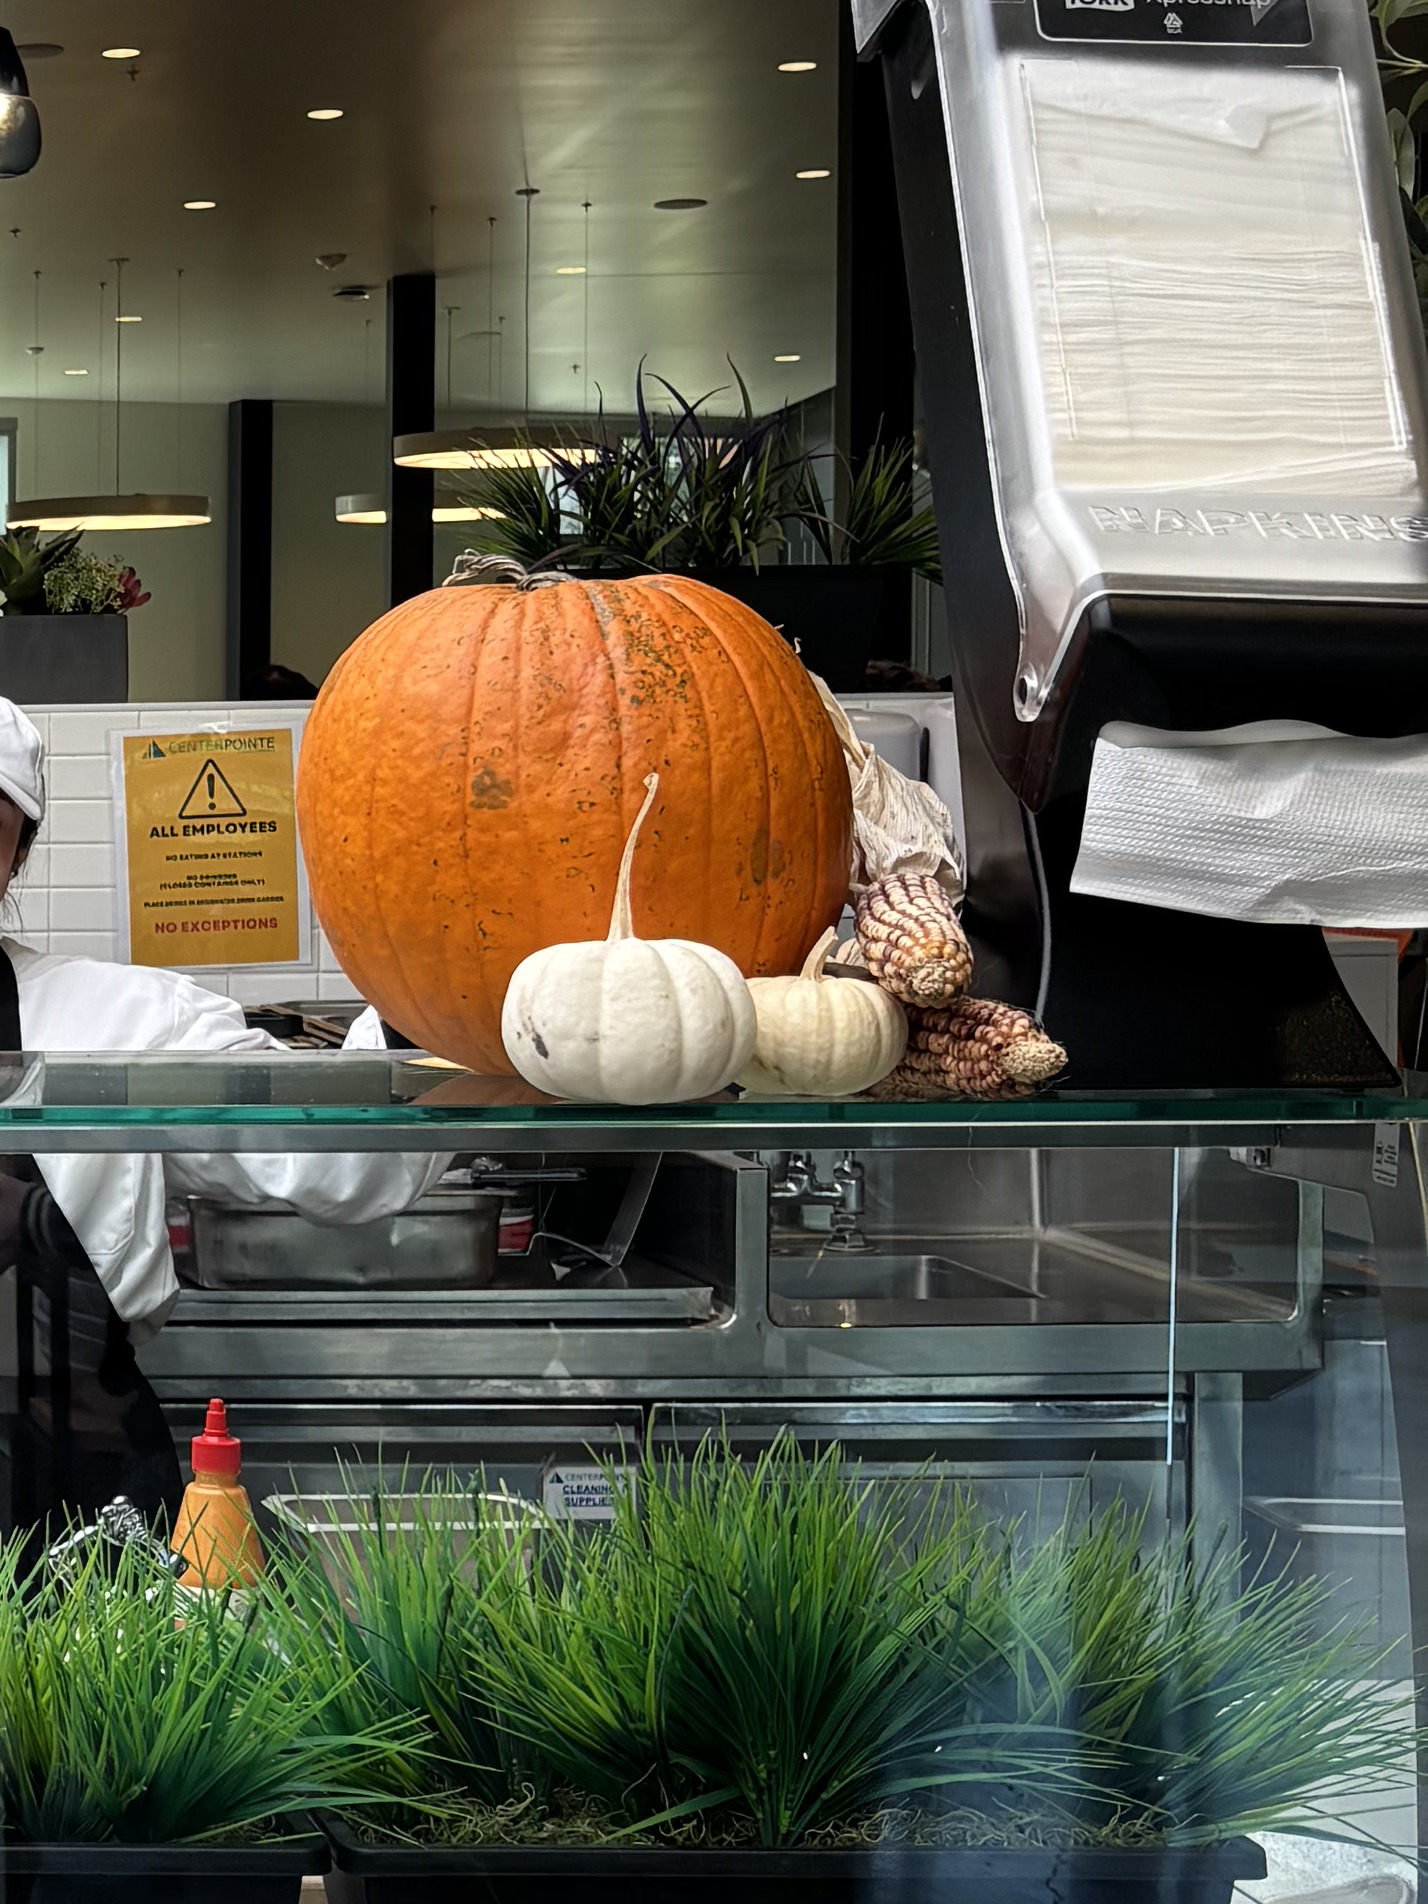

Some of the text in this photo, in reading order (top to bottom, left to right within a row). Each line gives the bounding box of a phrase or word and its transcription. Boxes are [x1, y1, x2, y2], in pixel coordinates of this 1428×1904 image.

[1088, 505, 1428, 543] NAPKINS
[168, 736, 276, 754] CENTERPOINTE
[149, 820, 278, 839] ALL EMPLOYEES
[154, 916, 279, 934] NO EXCEPTIONS
